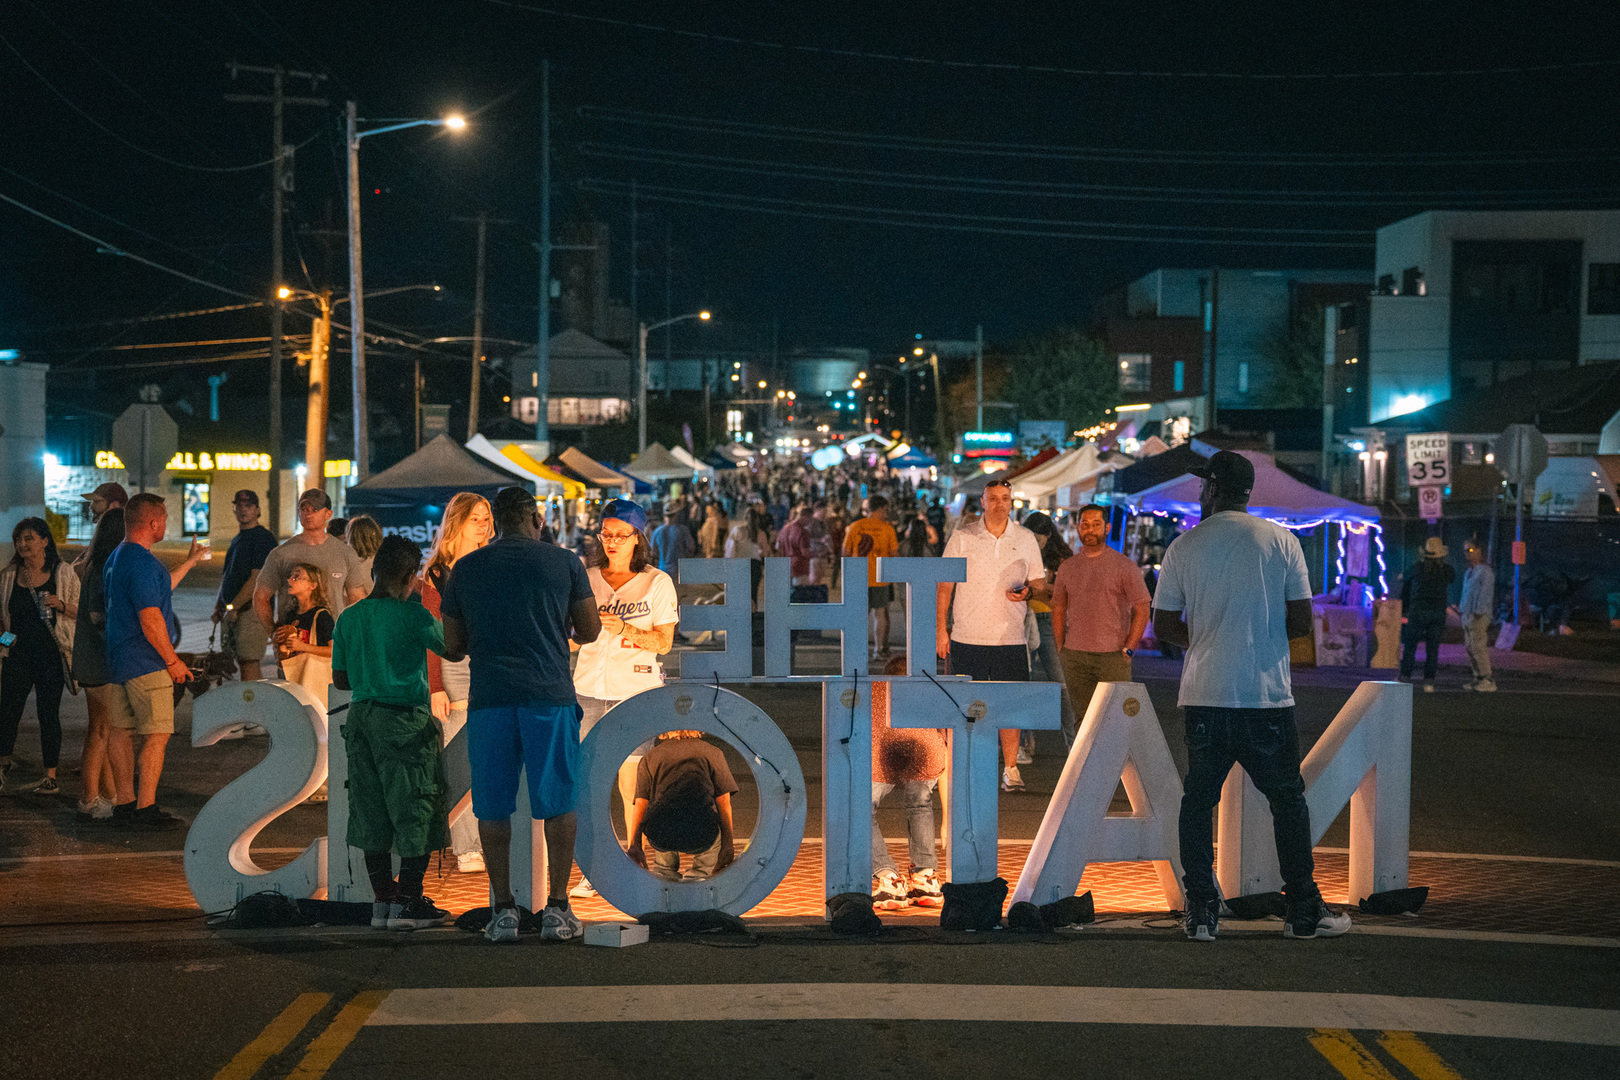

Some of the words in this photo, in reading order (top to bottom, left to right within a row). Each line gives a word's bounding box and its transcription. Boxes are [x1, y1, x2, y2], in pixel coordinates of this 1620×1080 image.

[1410, 439, 1446, 449] SPEED
[199, 452, 214, 471] &
[215, 452, 272, 471] WINGS
[1414, 450, 1441, 459] LIMIT
[1413, 460, 1446, 479] 35
[598, 599, 651, 621] odgers
